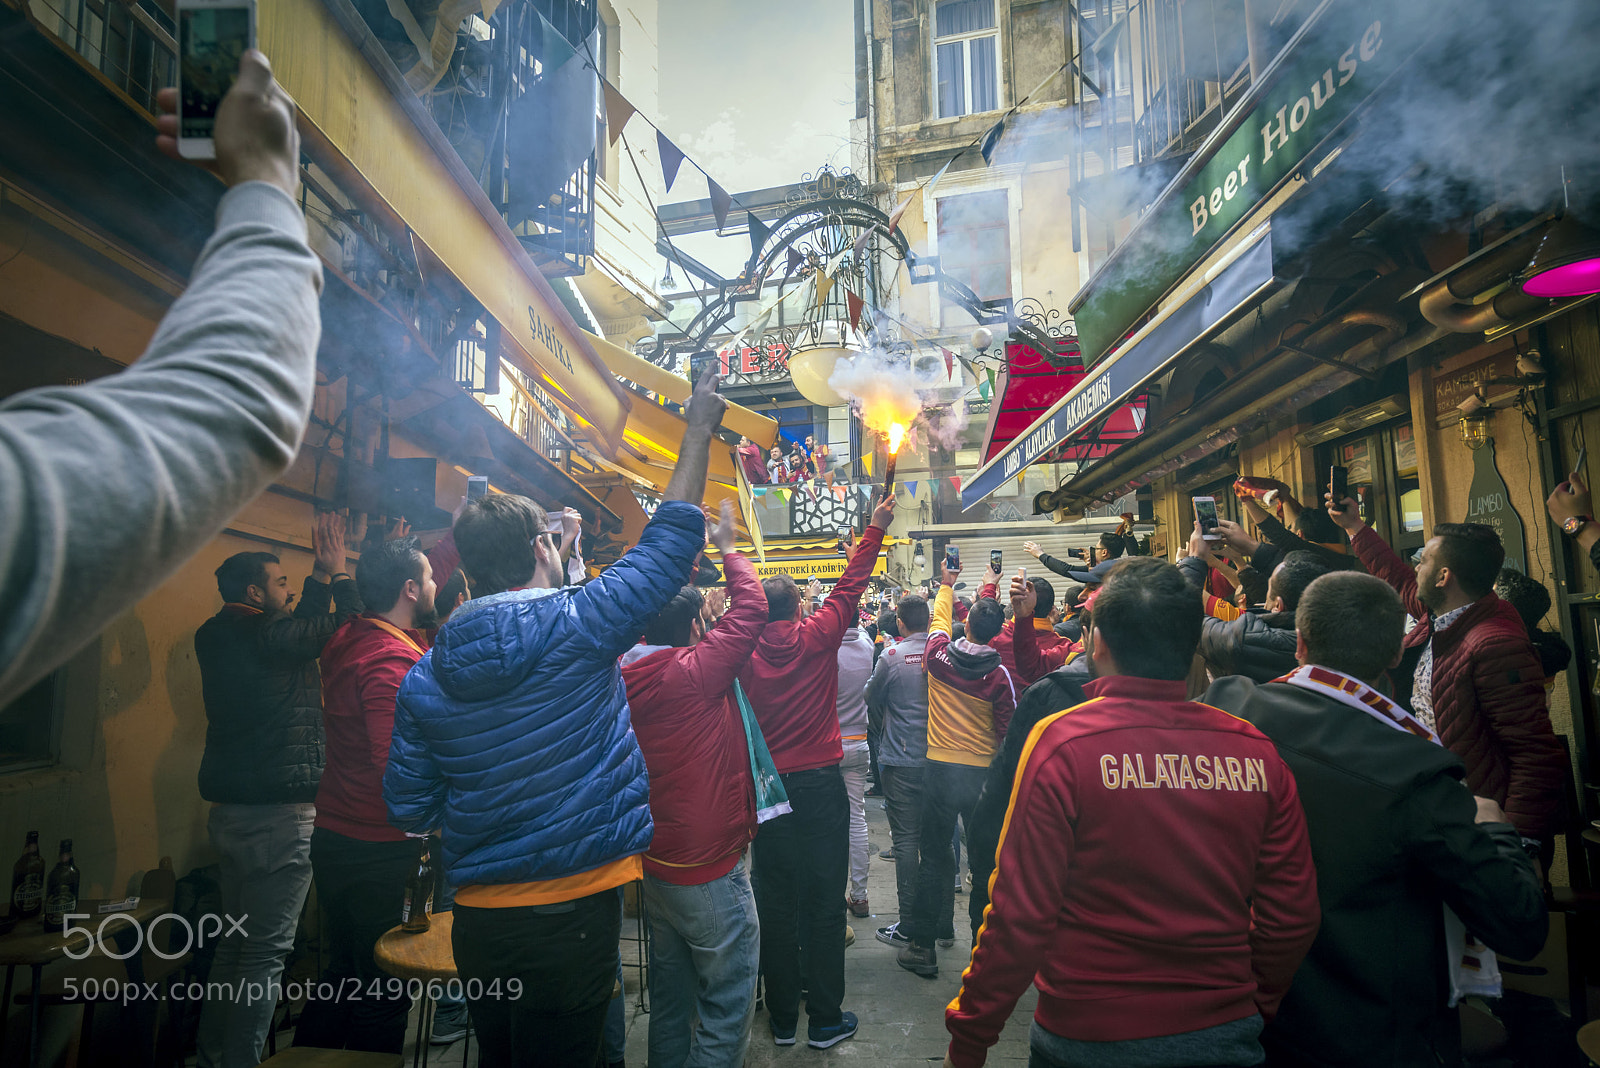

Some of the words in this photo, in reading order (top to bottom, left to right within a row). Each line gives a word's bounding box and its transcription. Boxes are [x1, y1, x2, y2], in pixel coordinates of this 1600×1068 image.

[1190, 153, 1250, 237] Beer
[1260, 20, 1383, 165] House
[528, 305, 574, 375] ŞAHİKA
[1025, 419, 1057, 462] ALAYLILAR
[1470, 493, 1503, 516] LAMBO
[758, 563, 809, 575] KREPEN'DEKİ
[1099, 753, 1268, 792] GALATASARAY
